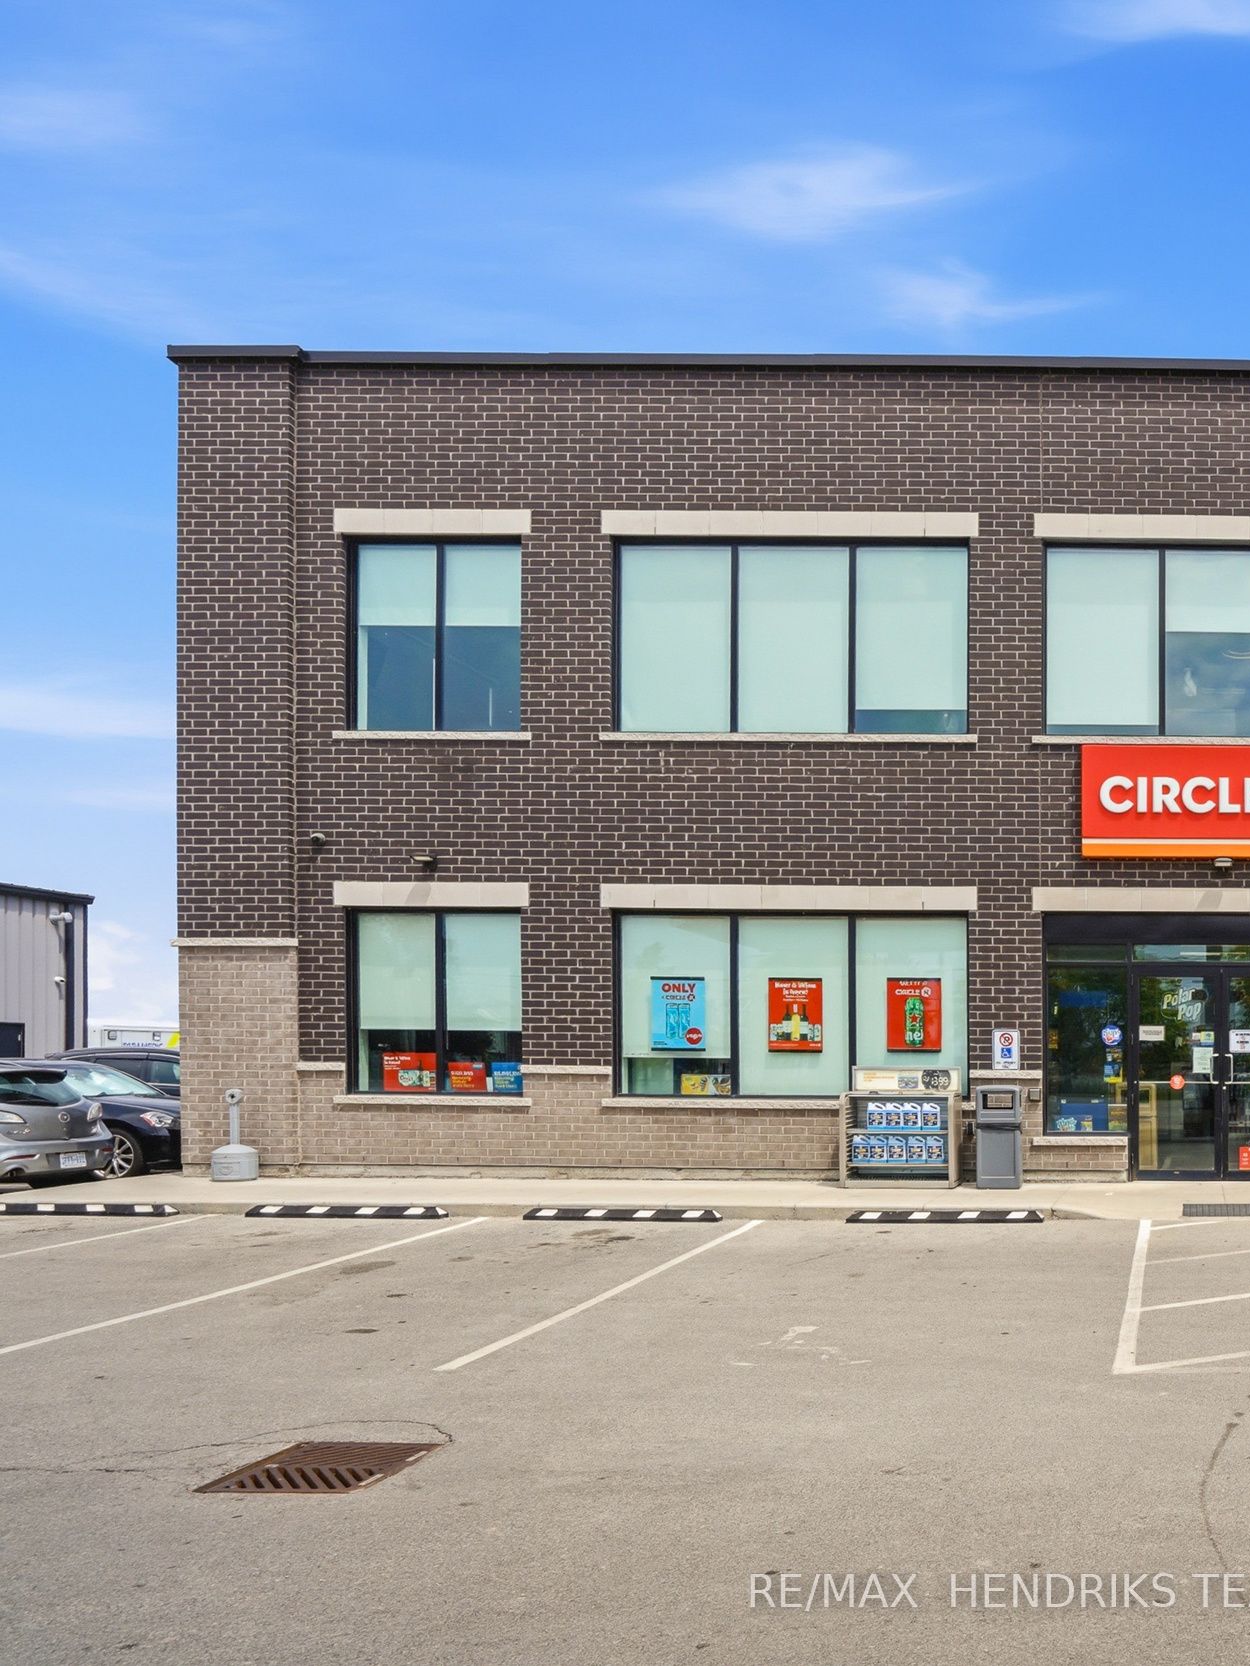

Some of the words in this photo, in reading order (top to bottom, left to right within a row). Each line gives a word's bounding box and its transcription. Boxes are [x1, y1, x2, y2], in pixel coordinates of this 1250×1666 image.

[662, 983, 696, 993] ONLY
[1163, 988, 1195, 1009] Polar
[1177, 1002, 1202, 1020] Pop
